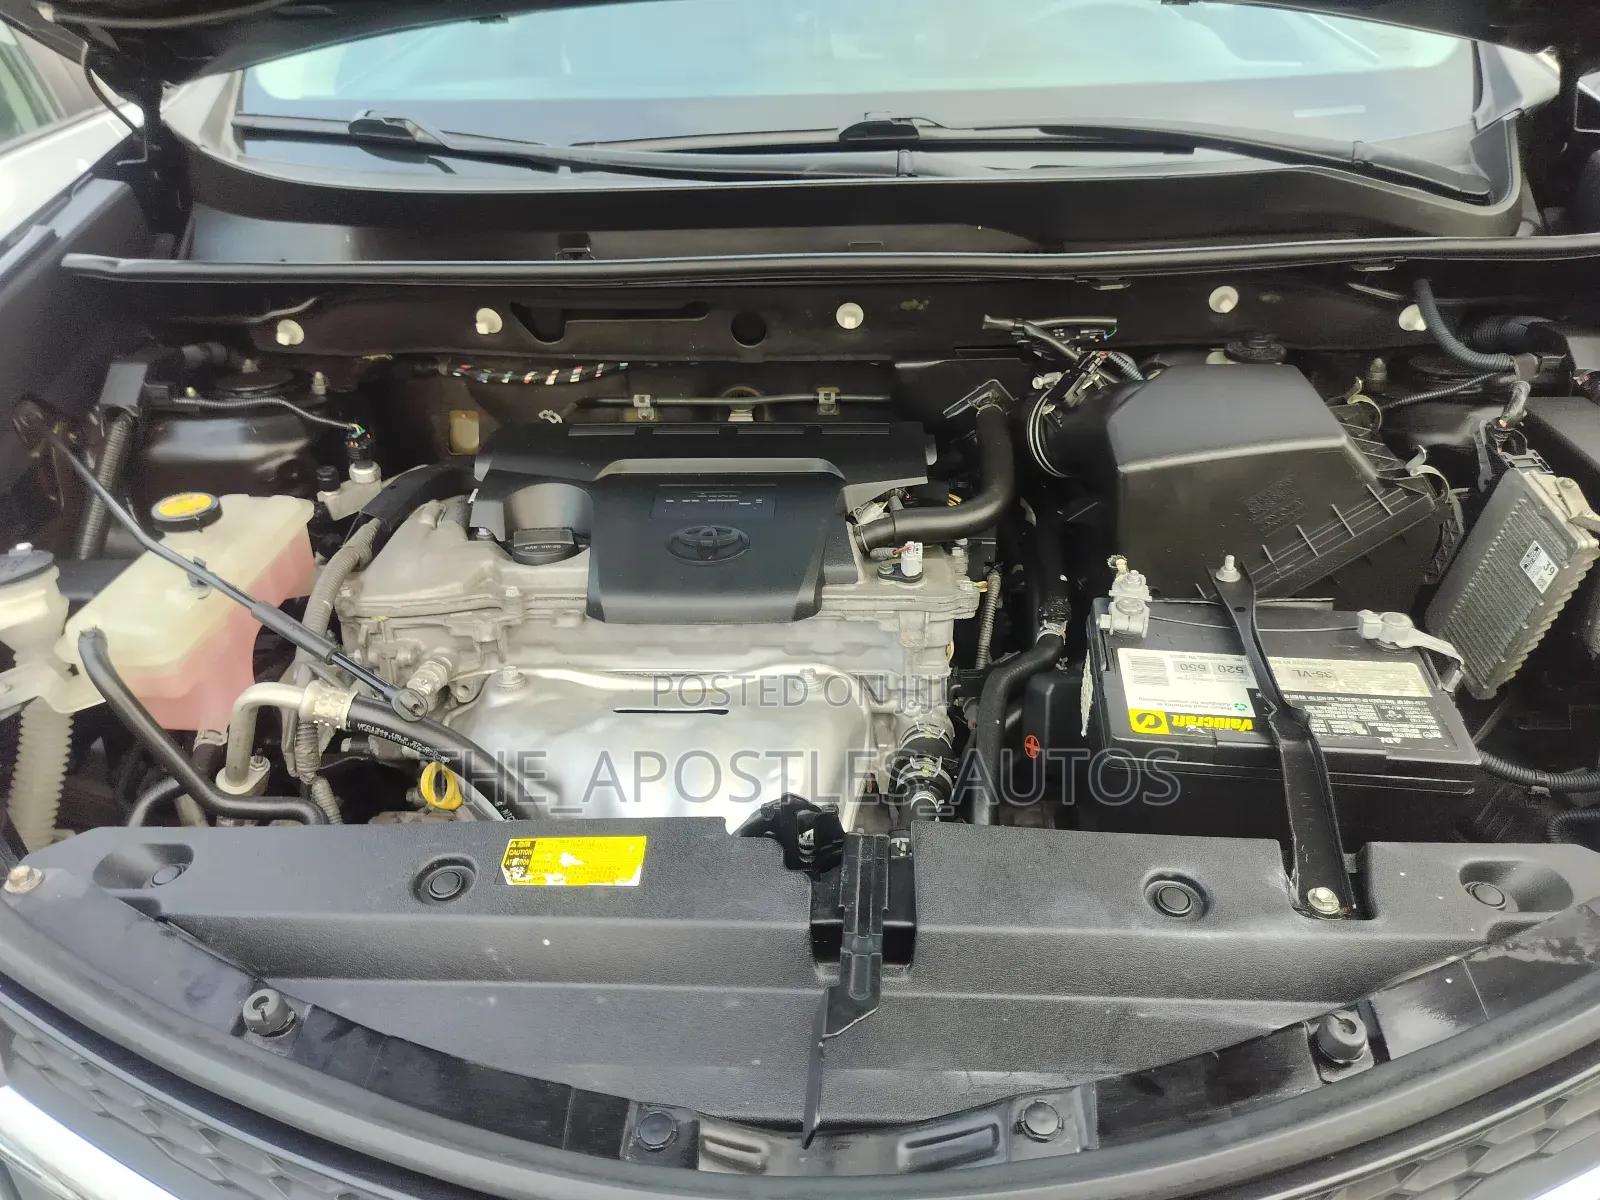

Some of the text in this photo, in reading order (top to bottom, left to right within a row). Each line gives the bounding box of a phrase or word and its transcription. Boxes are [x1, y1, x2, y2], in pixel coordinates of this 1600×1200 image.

[1180, 663, 1244, 673] 520 650
[1292, 669, 1332, 678] 35-VL
[1172, 715, 1253, 732] Valucraft
